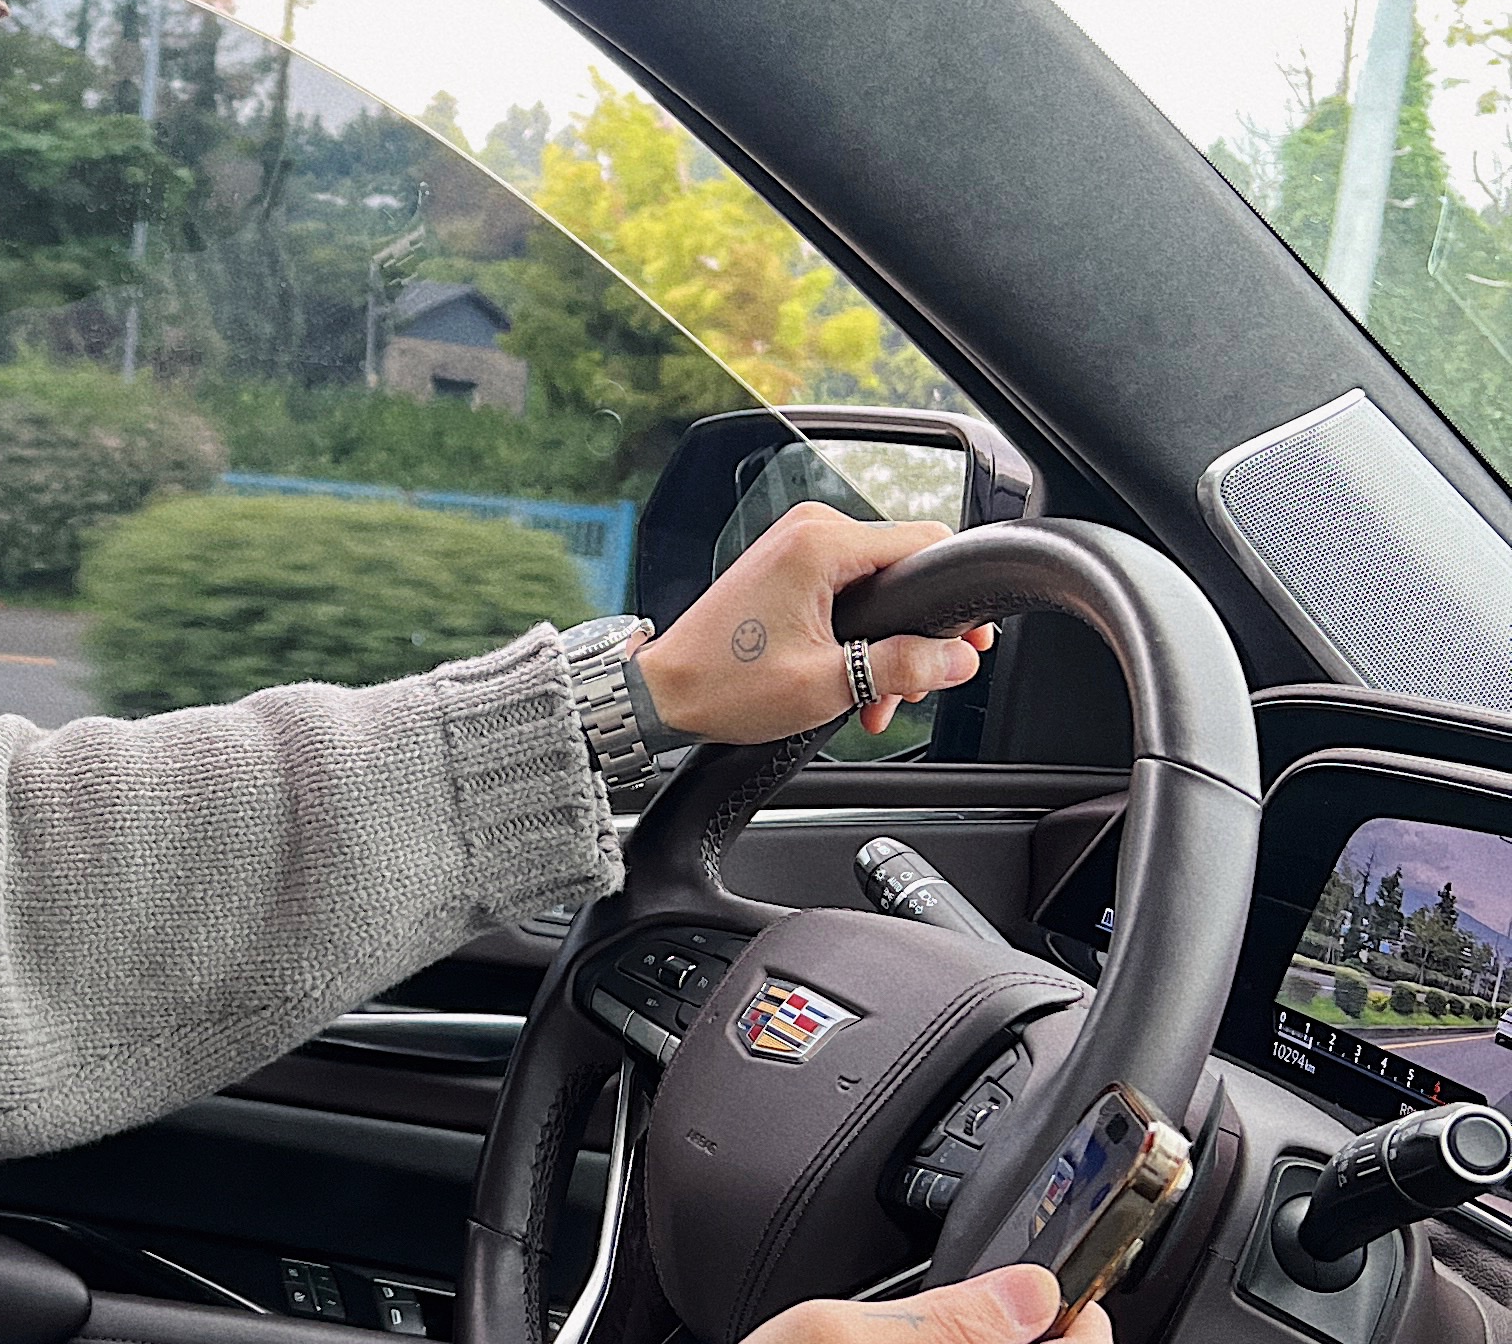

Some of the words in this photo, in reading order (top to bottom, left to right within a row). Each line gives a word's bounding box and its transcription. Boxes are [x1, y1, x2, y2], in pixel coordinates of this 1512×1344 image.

[1279, 1011, 1287, 1023] 0
[1305, 1022, 1311, 1034] 1
[1328, 1032, 1337, 1045] 2
[1354, 1044, 1362, 1057] 3
[1380, 1057, 1388, 1069] 4
[1406, 1068, 1415, 1081] 5
